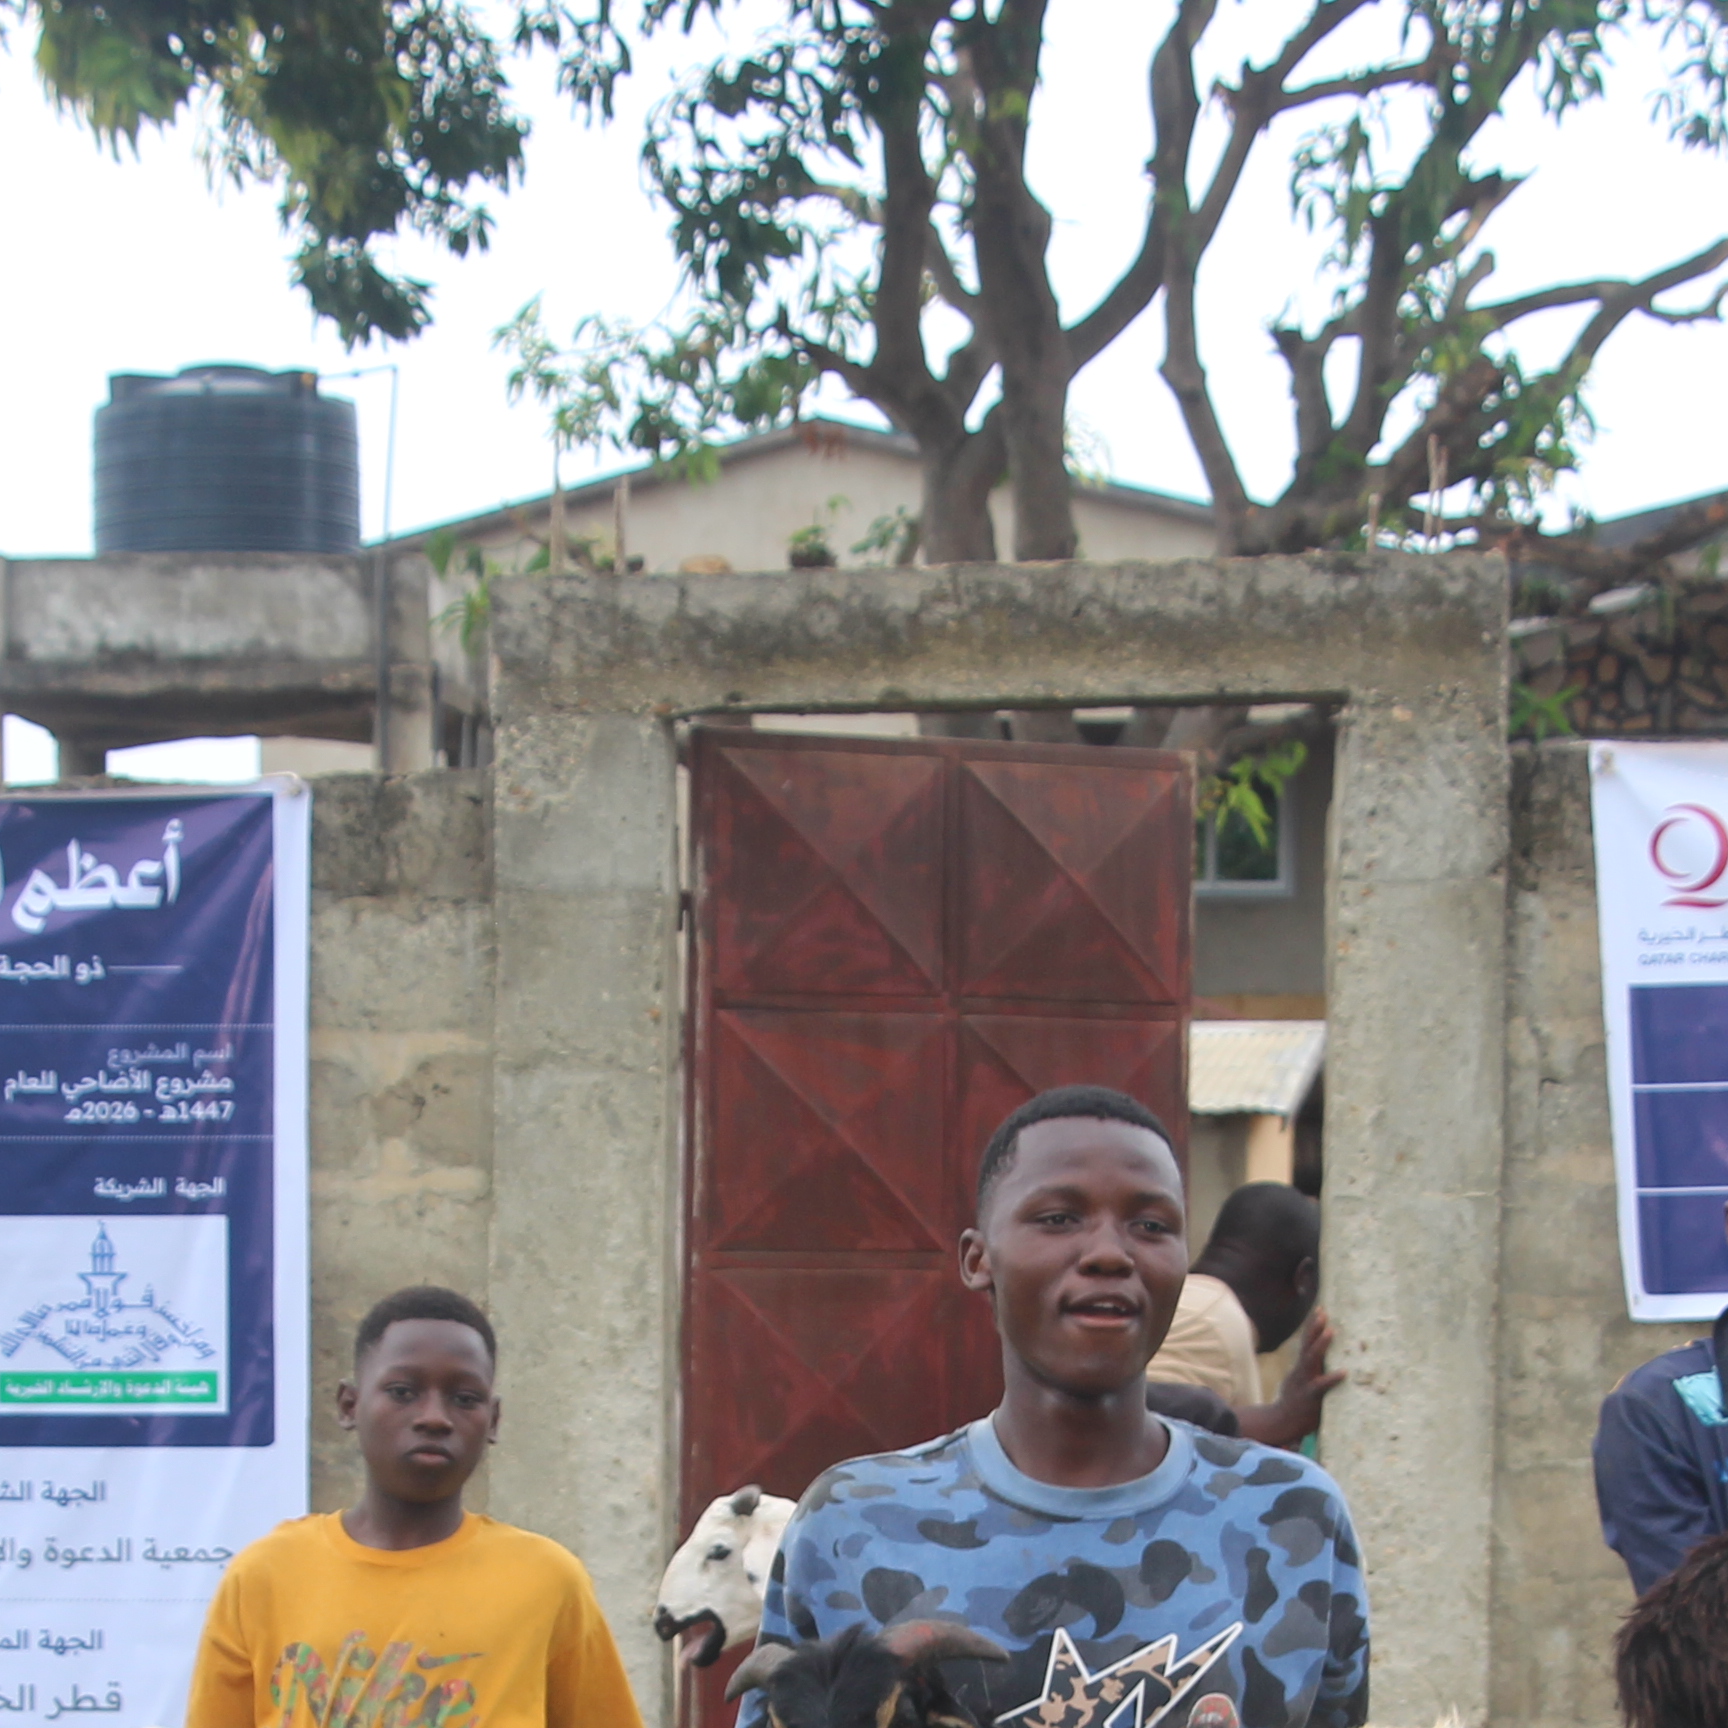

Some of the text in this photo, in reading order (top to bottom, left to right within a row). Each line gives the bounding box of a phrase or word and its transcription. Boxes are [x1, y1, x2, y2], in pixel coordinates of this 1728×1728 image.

[11, 818, 184, 934] أعظم
[75, 955, 105, 982] ذو
[1638, 952, 1684, 966] QATAR
[108, 1043, 234, 1071] اسم المشروع
[4, 1068, 235, 1103] مشروع الأضاحي للعام
[93, 1177, 227, 1200] الجهة الشريكة
[41, 1479, 106, 1506] الجهة
[43, 1537, 130, 1568] الدعوة
[142, 1537, 233, 1570] جمعية
[38, 1628, 104, 1655] الجهة
[44, 1681, 123, 1719] قطر
